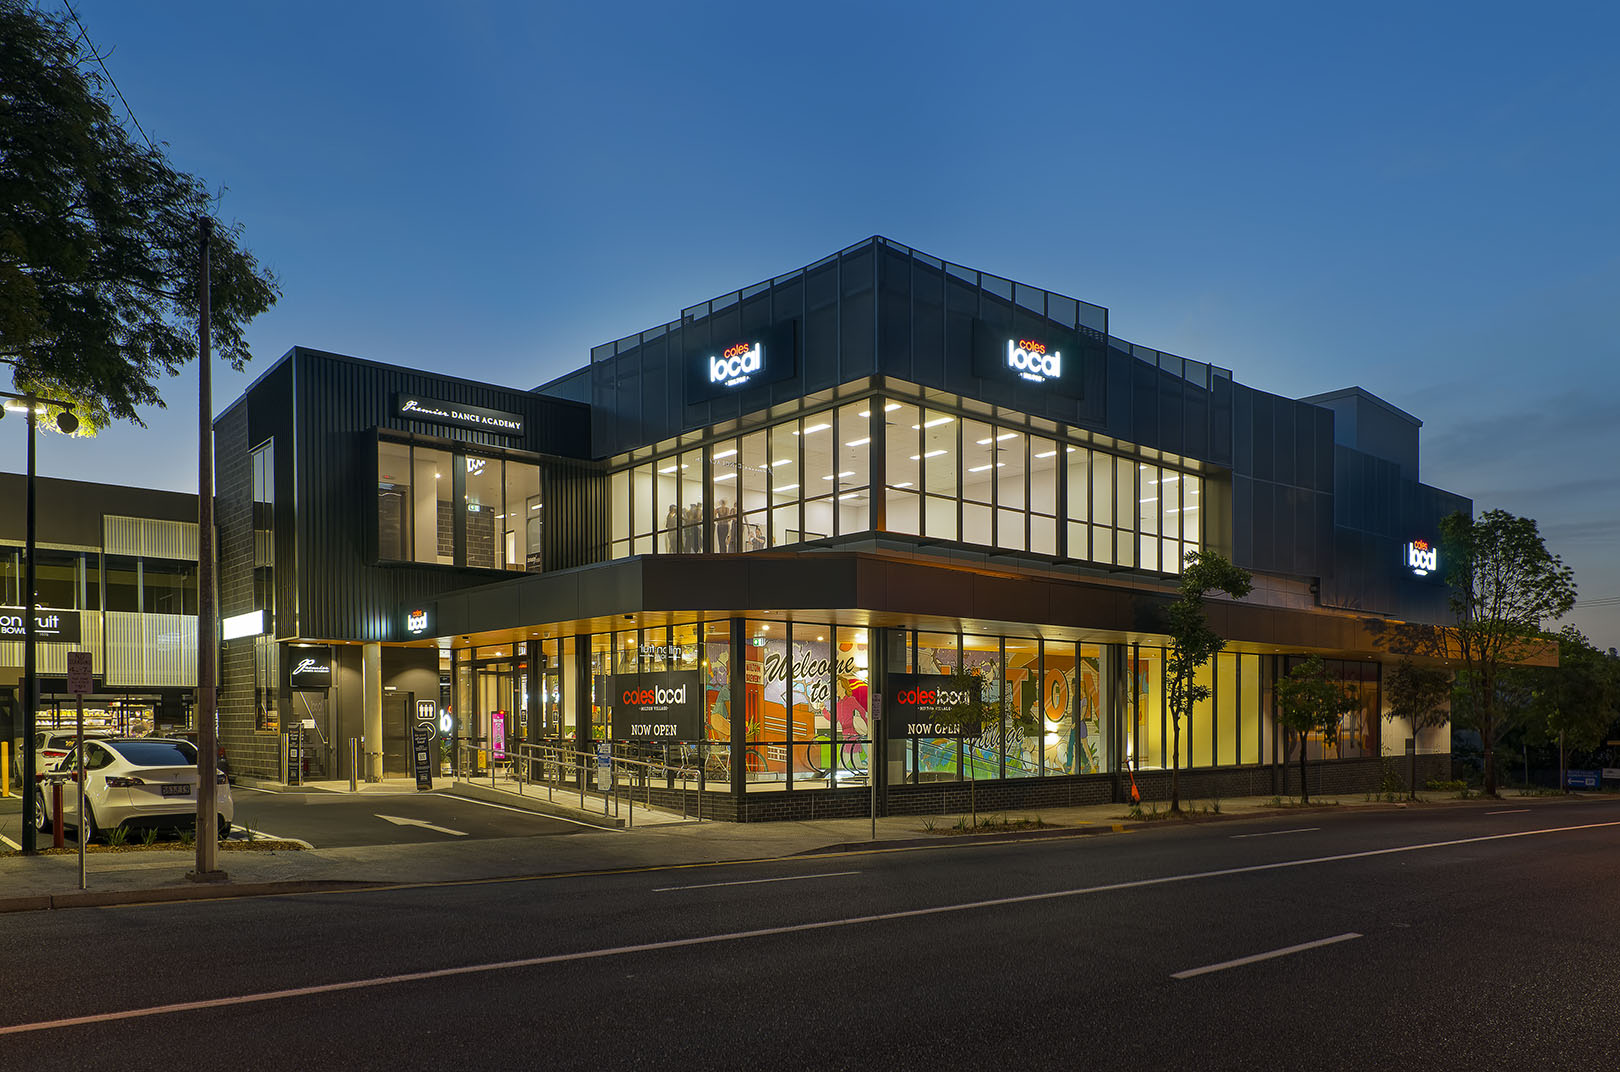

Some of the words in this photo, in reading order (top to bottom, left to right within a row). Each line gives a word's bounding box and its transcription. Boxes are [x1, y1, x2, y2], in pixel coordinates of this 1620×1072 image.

[724, 343, 750, 358] coles
[1019, 339, 1046, 354] coles
[710, 342, 761, 382] local
[1008, 339, 1060, 378] local
[451, 411, 480, 423] DANCE
[482, 416, 521, 430] ACADEMY
[1409, 542, 1437, 571] local
[407, 611, 427, 631] local
[766, 651, 855, 682] Welcome
[811, 680, 829, 702] to
[631, 724, 651, 736] NOW
[653, 724, 677, 736] OPEN
[907, 723, 931, 735] NOW
